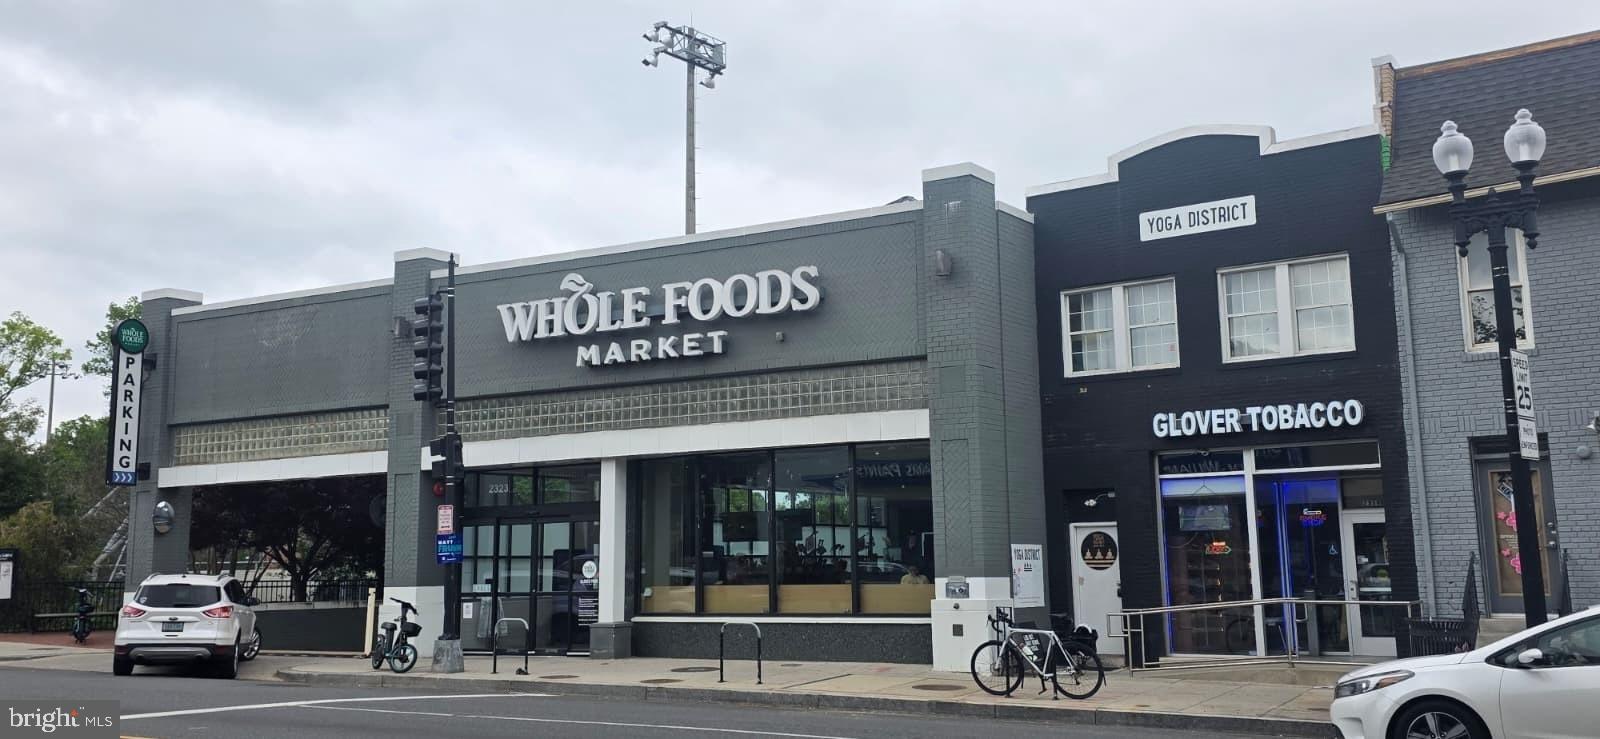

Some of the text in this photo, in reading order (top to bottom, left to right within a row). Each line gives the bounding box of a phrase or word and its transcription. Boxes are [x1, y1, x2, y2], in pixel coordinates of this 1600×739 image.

[1147, 202, 1248, 234] YOGA DISTRICT
[497, 265, 820, 342] WHOLE FOODS
[121, 328, 144, 337] WHOLE
[122, 335, 144, 343] FOODS
[576, 330, 728, 367] MARKET
[1512, 358, 1528, 370] SPEED
[1515, 370, 1528, 383] LIMIT
[1517, 386, 1532, 411] 25
[119, 357, 135, 468] PARKING
[1152, 399, 1363, 438] GLOVER TOBACCO
[488, 484, 508, 494] 2323
